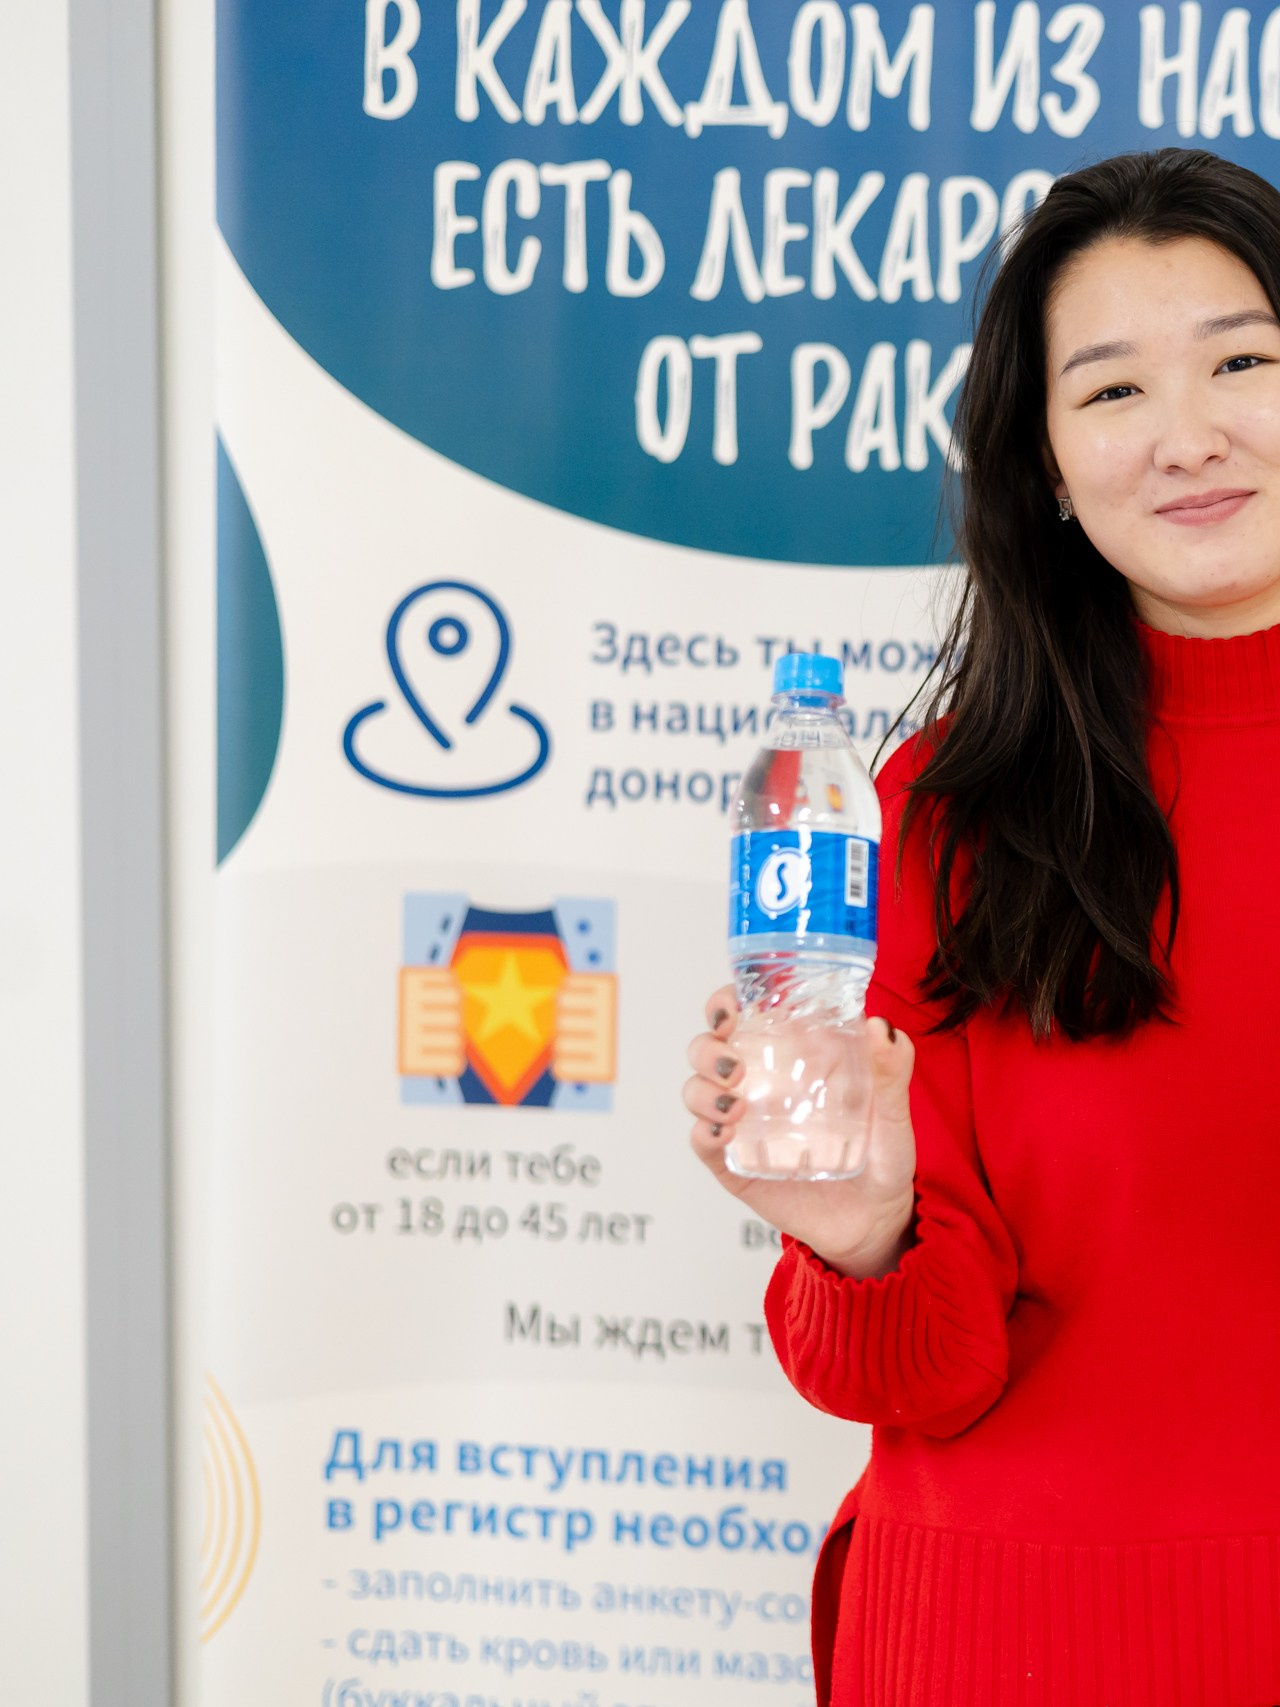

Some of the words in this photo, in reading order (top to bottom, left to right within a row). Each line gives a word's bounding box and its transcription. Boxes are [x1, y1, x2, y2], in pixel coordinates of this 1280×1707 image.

[363, 0, 422, 120] В
[455, 0, 936, 139] КАЖДОМ
[970, 0, 1106, 138] ИЗ
[432, 158, 666, 297] ЕСТЬ
[690, 166, 1070, 303] ЛЕКАРС
[633, 331, 763, 466] ОТ
[591, 622, 740, 674] Здесь
[842, 638, 966, 674] мож
[590, 699, 615, 732] в
[387, 1146, 491, 1182] если
[503, 1142, 603, 1189] тебе
[330, 1201, 382, 1237] от
[397, 1196, 446, 1238] 18
[453, 1204, 510, 1245] до
[517, 1201, 570, 1243] 45
[577, 1210, 655, 1246] лет
[504, 1300, 580, 1347] Мы
[596, 1312, 731, 1359] ждем
[324, 1429, 438, 1483] Для
[456, 1440, 788, 1493] вступления
[325, 1498, 353, 1531] в
[373, 1498, 595, 1553] регистр
[347, 1567, 583, 1613] заполнить
[346, 1625, 471, 1670] сдать
[480, 1634, 609, 1677] кровь
[619, 1643, 702, 1679] или
